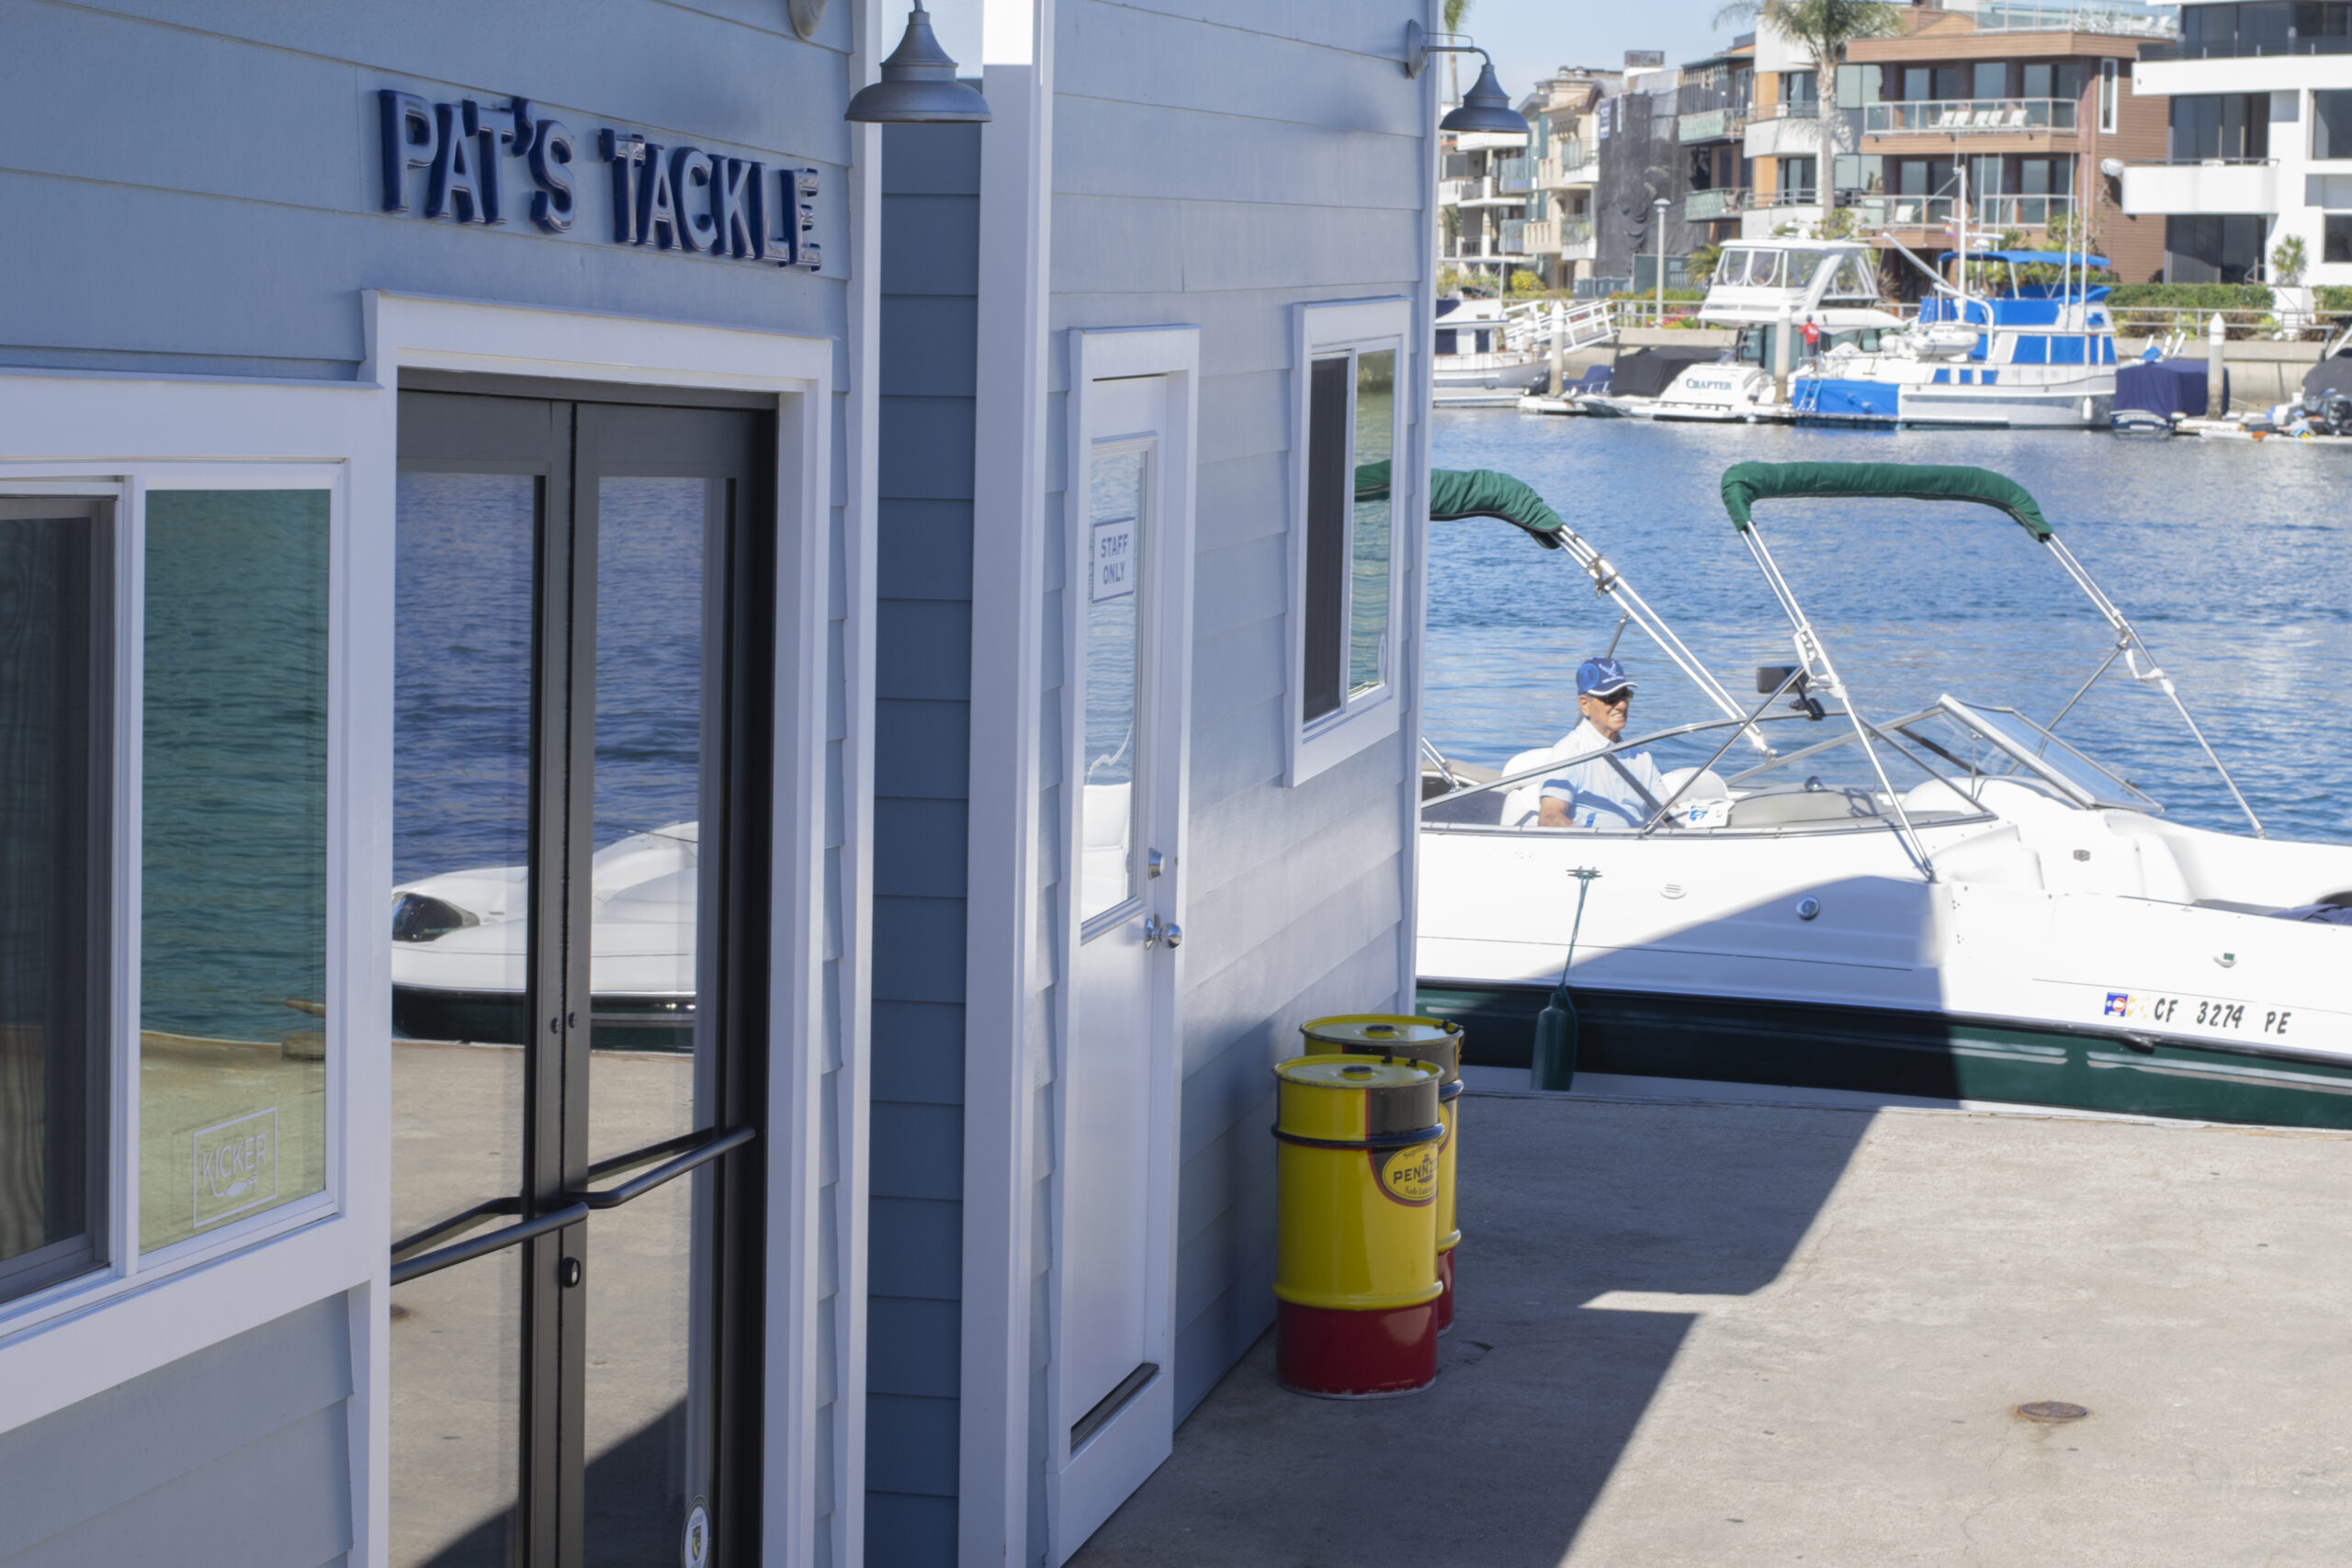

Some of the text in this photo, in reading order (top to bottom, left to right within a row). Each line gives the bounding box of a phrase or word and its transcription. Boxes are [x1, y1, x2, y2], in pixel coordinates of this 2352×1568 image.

[379, 89, 821, 271] PAT'S TACKLE
[1101, 534, 1128, 558] STAFF
[1103, 561, 1125, 585] ONLY
[2154, 998, 2291, 1034] CF 3274 PE
[202, 1134, 267, 1186] KICKER
